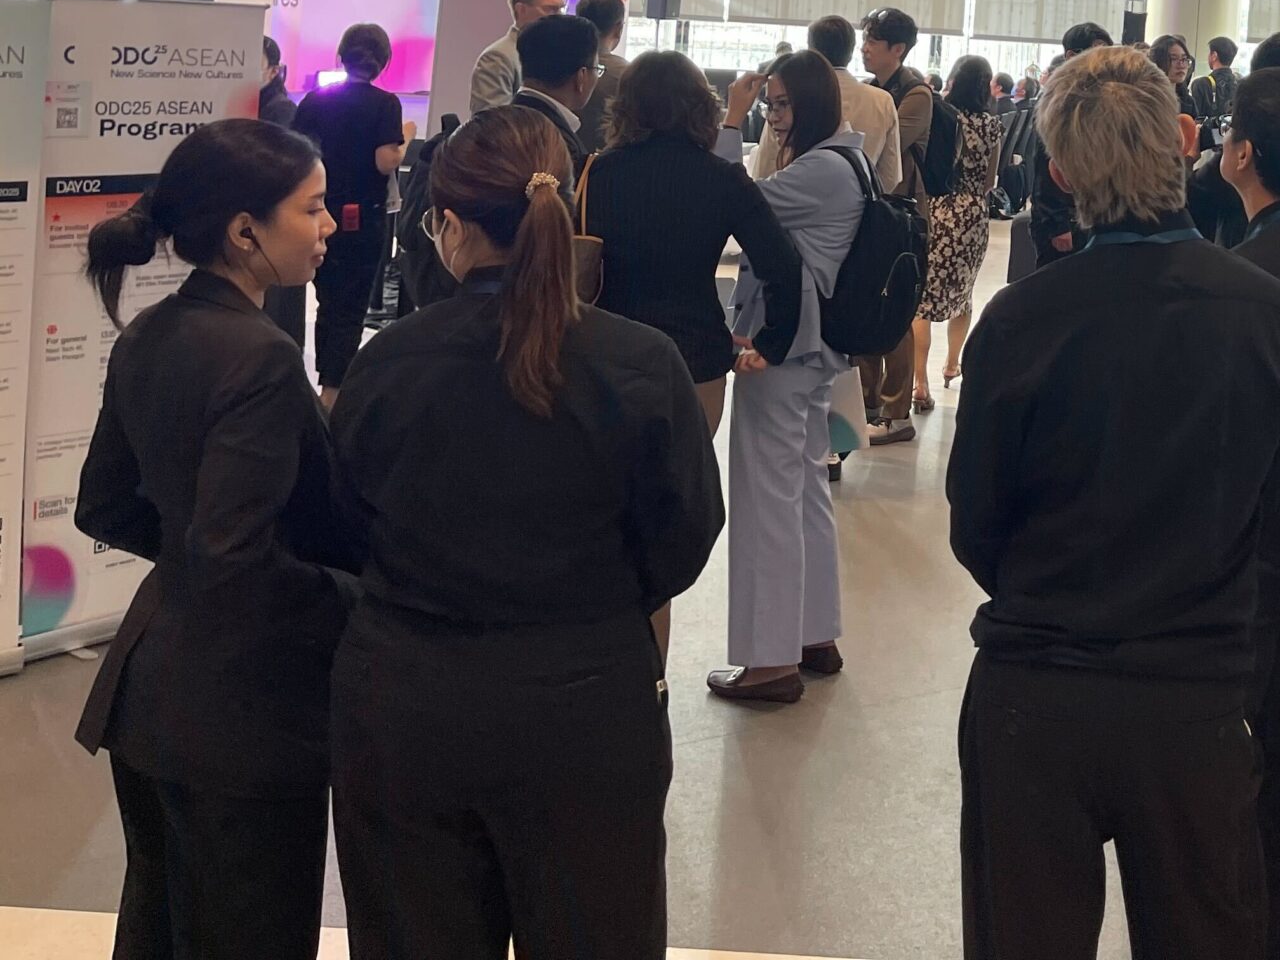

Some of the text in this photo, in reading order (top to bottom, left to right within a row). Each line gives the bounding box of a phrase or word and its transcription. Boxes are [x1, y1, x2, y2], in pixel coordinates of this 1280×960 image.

[168, 48, 246, 67] ASEAN
[110, 69, 134, 79] New
[137, 69, 176, 79] Science
[179, 70, 203, 80] New
[95, 101, 213, 115] ODC25 ASEAN
